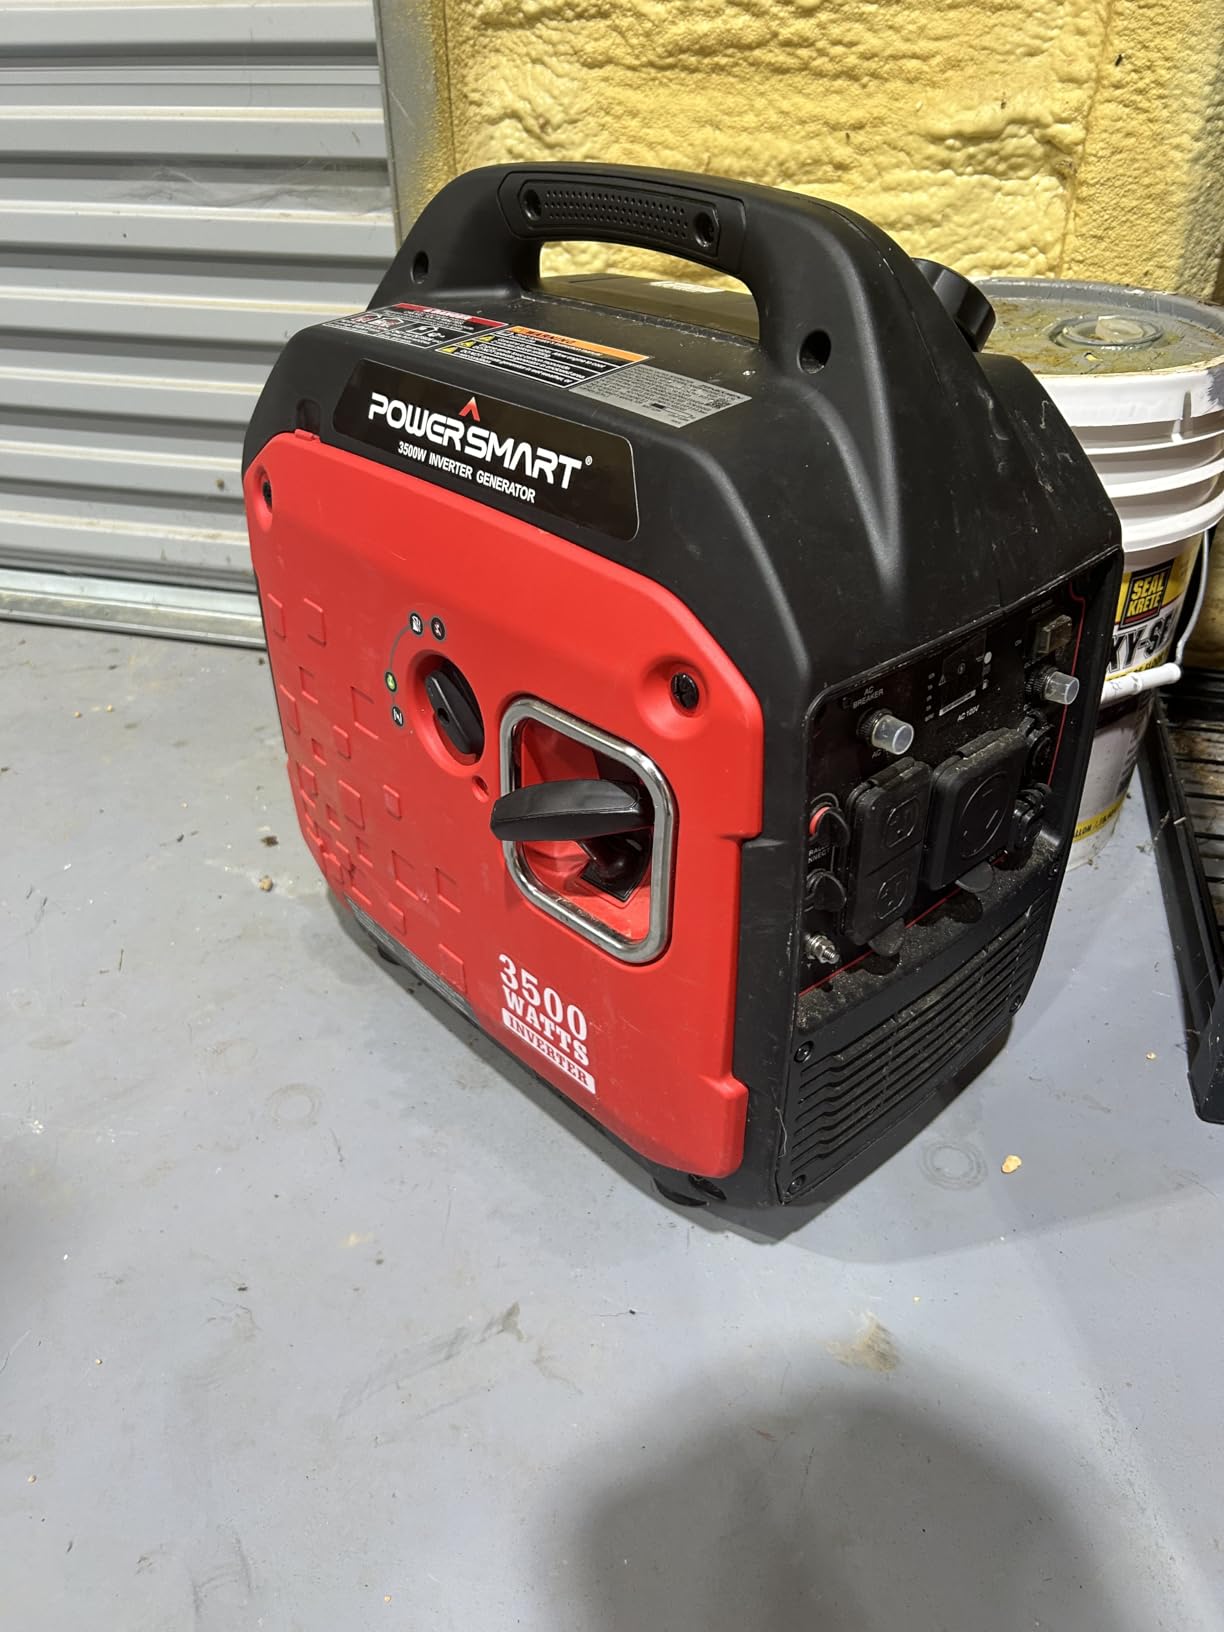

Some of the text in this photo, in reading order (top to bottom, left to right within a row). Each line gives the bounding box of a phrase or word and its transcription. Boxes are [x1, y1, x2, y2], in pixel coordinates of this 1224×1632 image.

[367, 391, 583, 490] POWERSMART
[398, 441, 536, 504] 3500W INVERTER GENERATOR
[1126, 591, 1162, 617] KRETE
[1131, 571, 1165, 601] SEAL
[852, 687, 884, 709] BREAKER
[863, 685, 875, 697] AC
[498, 953, 588, 1041] 3500
[501, 984, 590, 1067] WATTS
[508, 1016, 589, 1088] INVERTER
